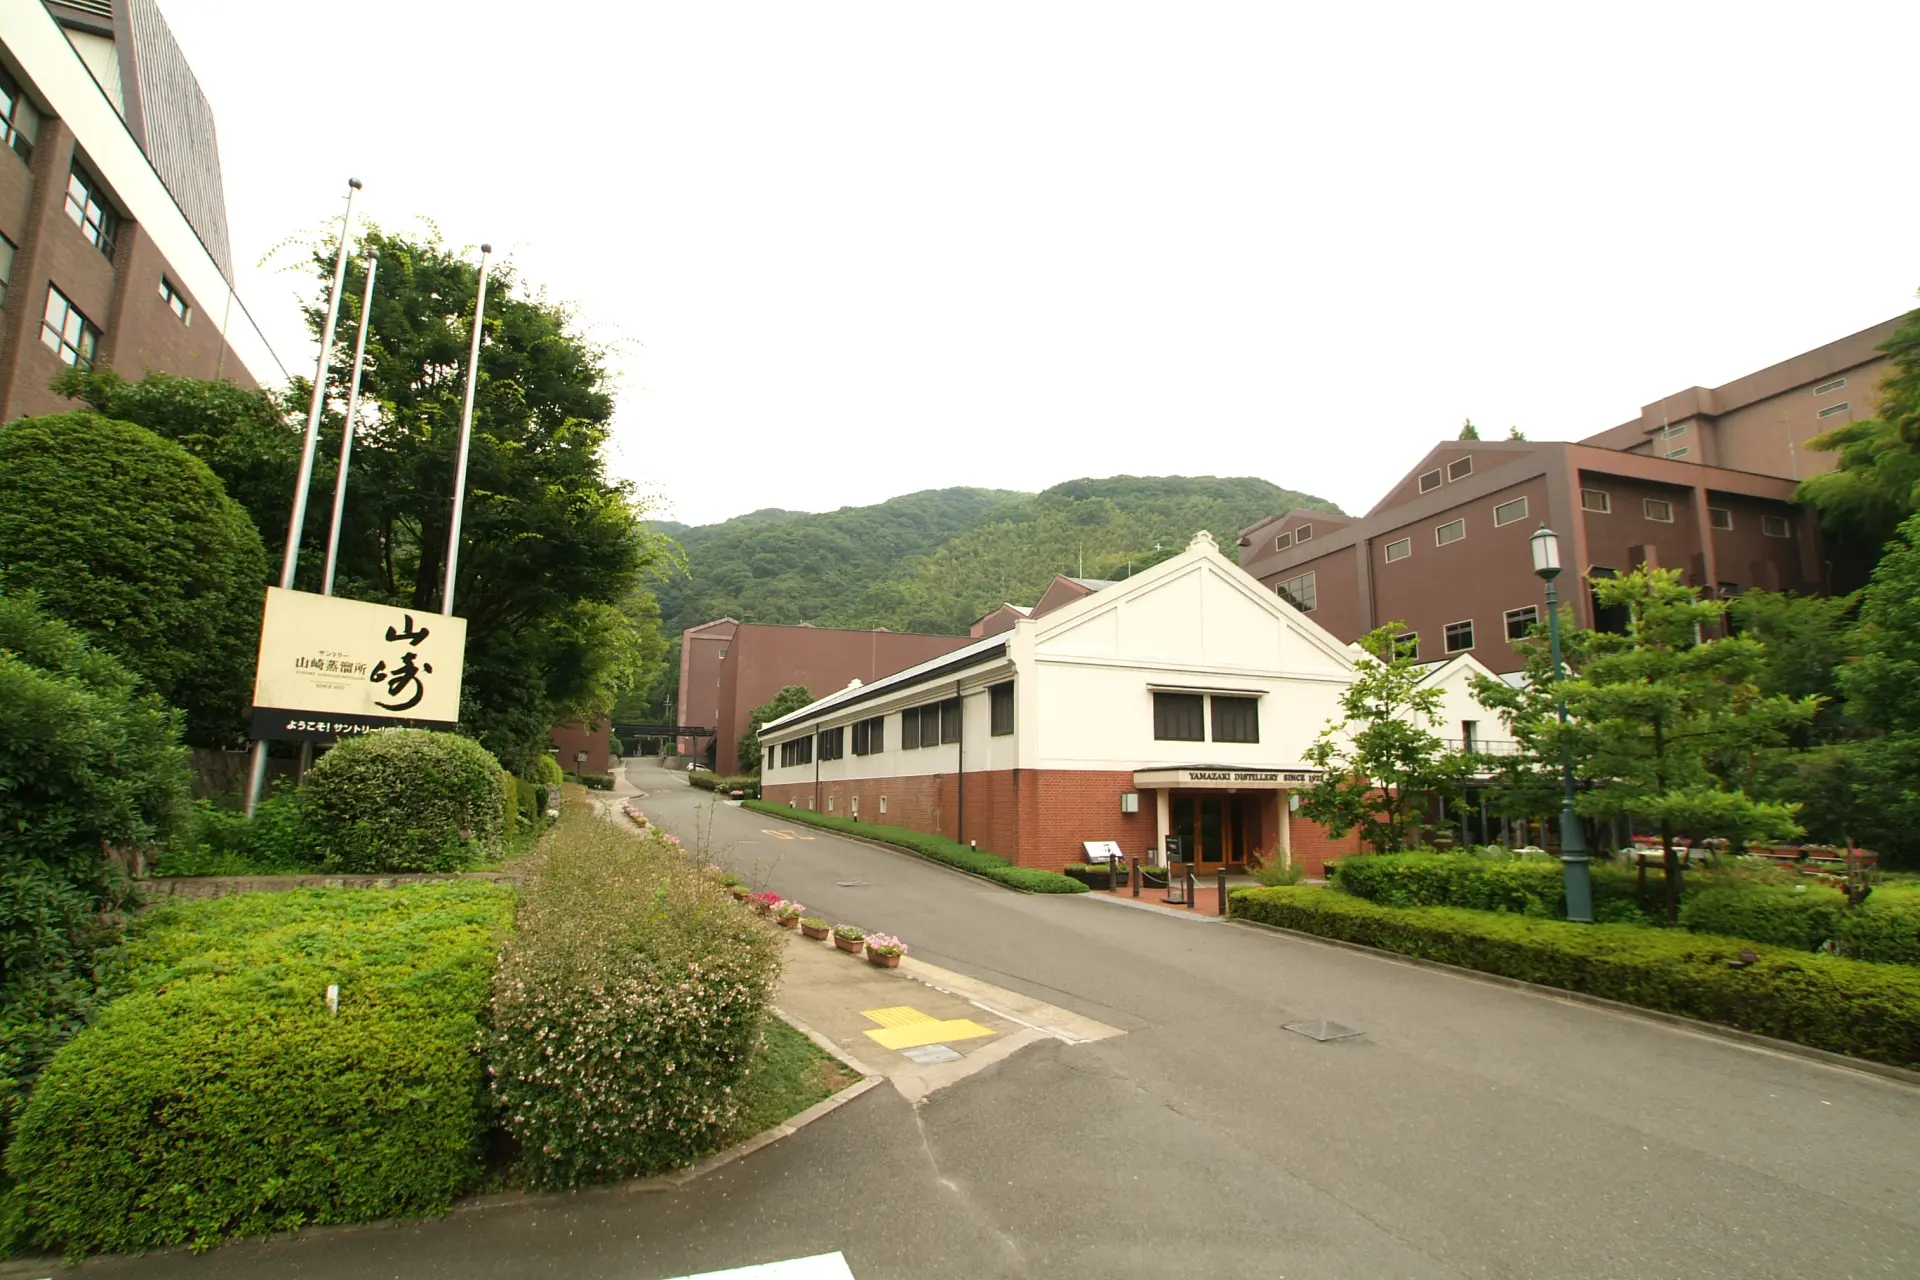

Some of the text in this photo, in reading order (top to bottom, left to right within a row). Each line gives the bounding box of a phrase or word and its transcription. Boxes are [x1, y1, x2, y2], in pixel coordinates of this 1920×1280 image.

[318, 650, 350, 658] サントリー
[295, 656, 368, 675] 山崎蒸溜所
[1189, 772, 1231, 781] YAMAZAKI
[1234, 773, 1278, 782] DISTILLERY
[1284, 774, 1306, 782] SINCE
